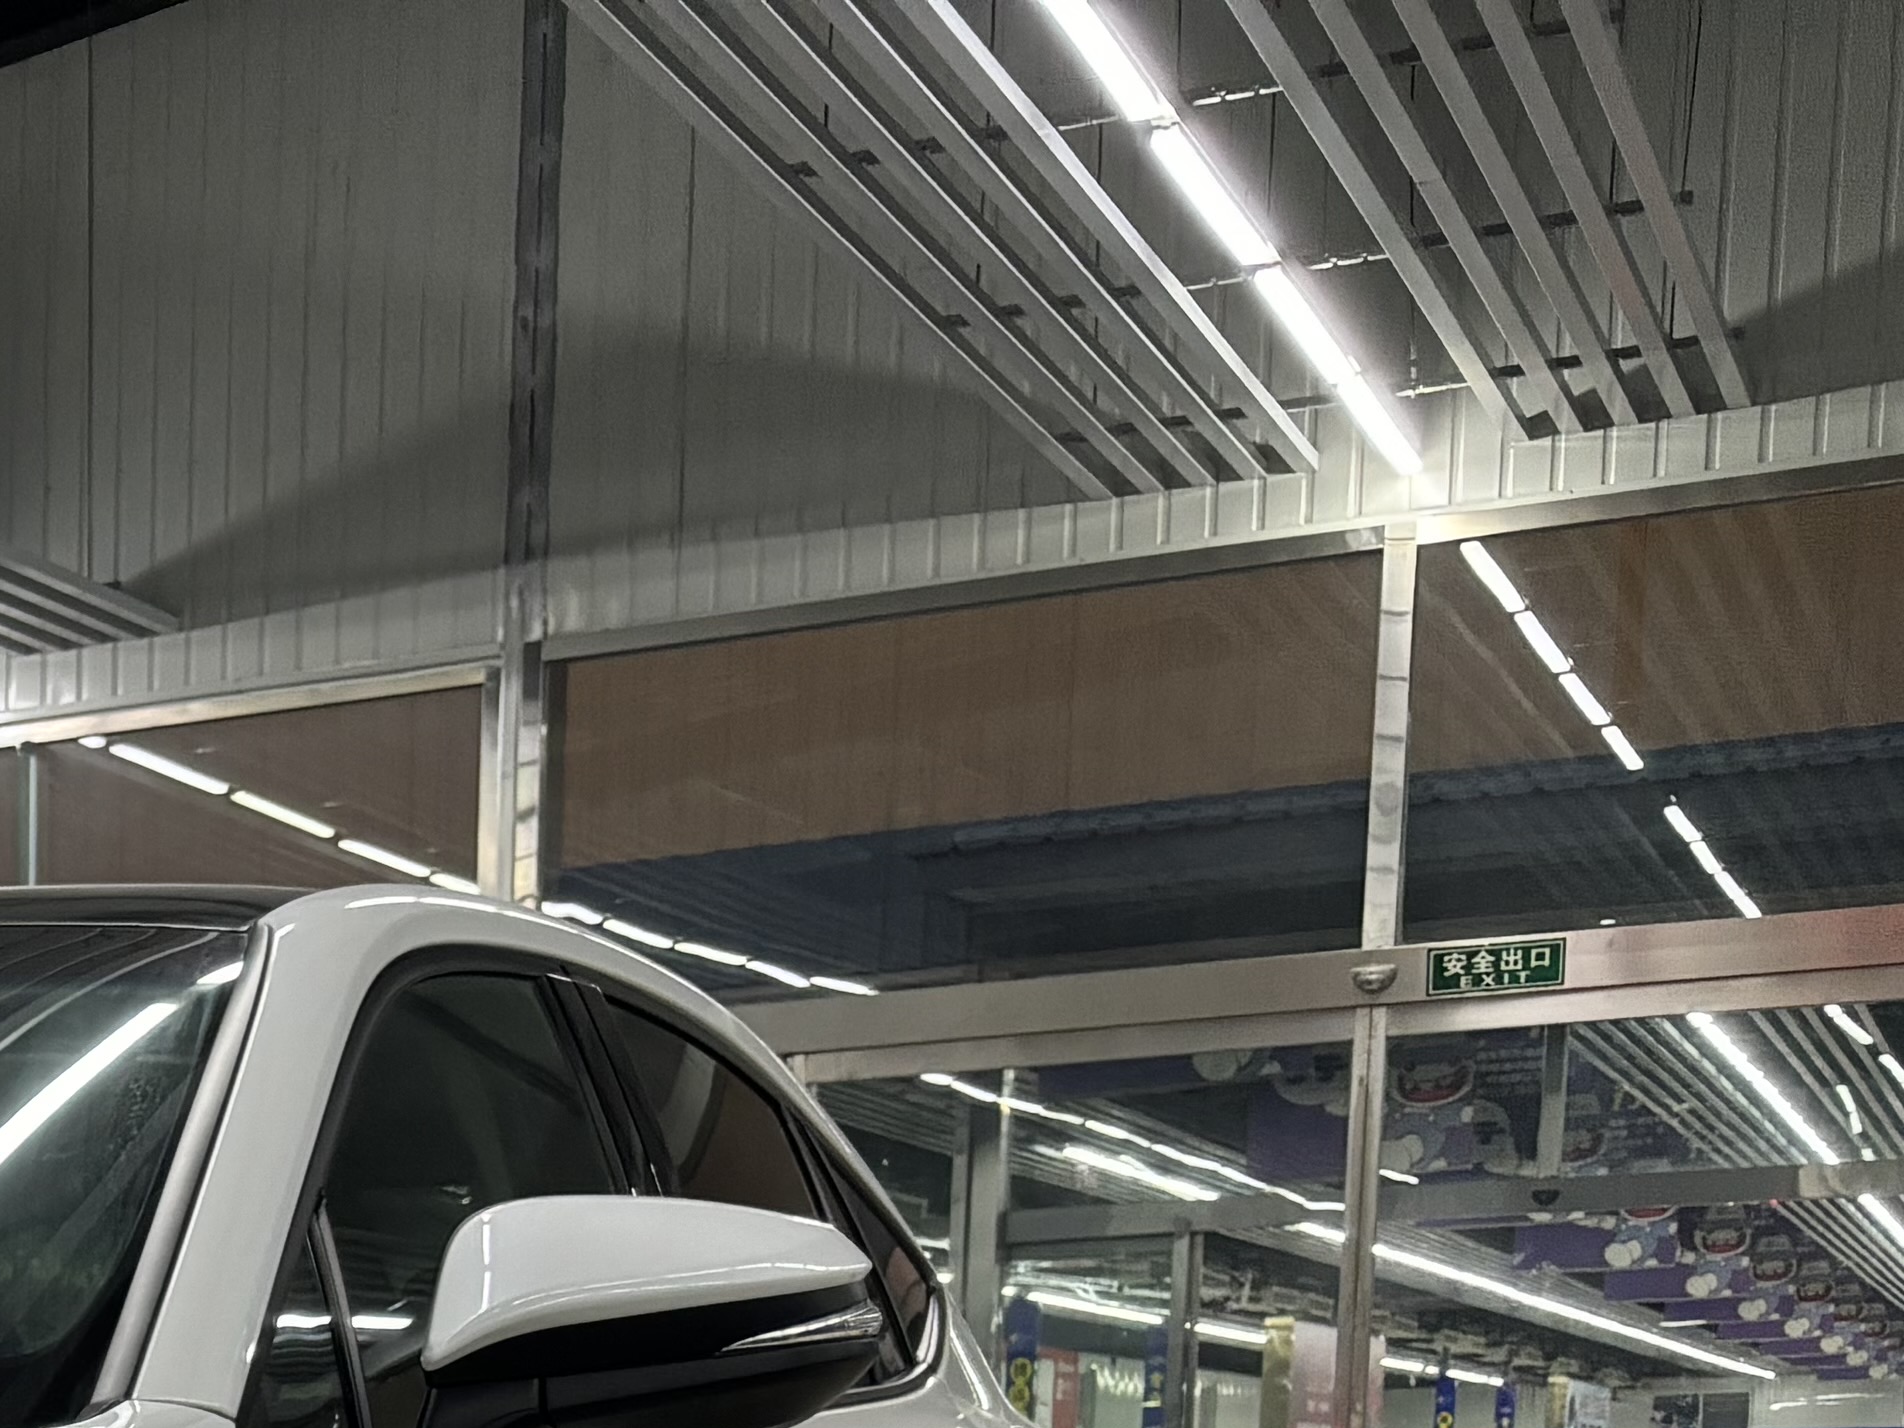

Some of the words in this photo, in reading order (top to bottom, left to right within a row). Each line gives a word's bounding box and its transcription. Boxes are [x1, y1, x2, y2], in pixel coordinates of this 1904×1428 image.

[1442, 947, 1552, 977] 安全出口
[1459, 970, 1532, 989] EXIT
